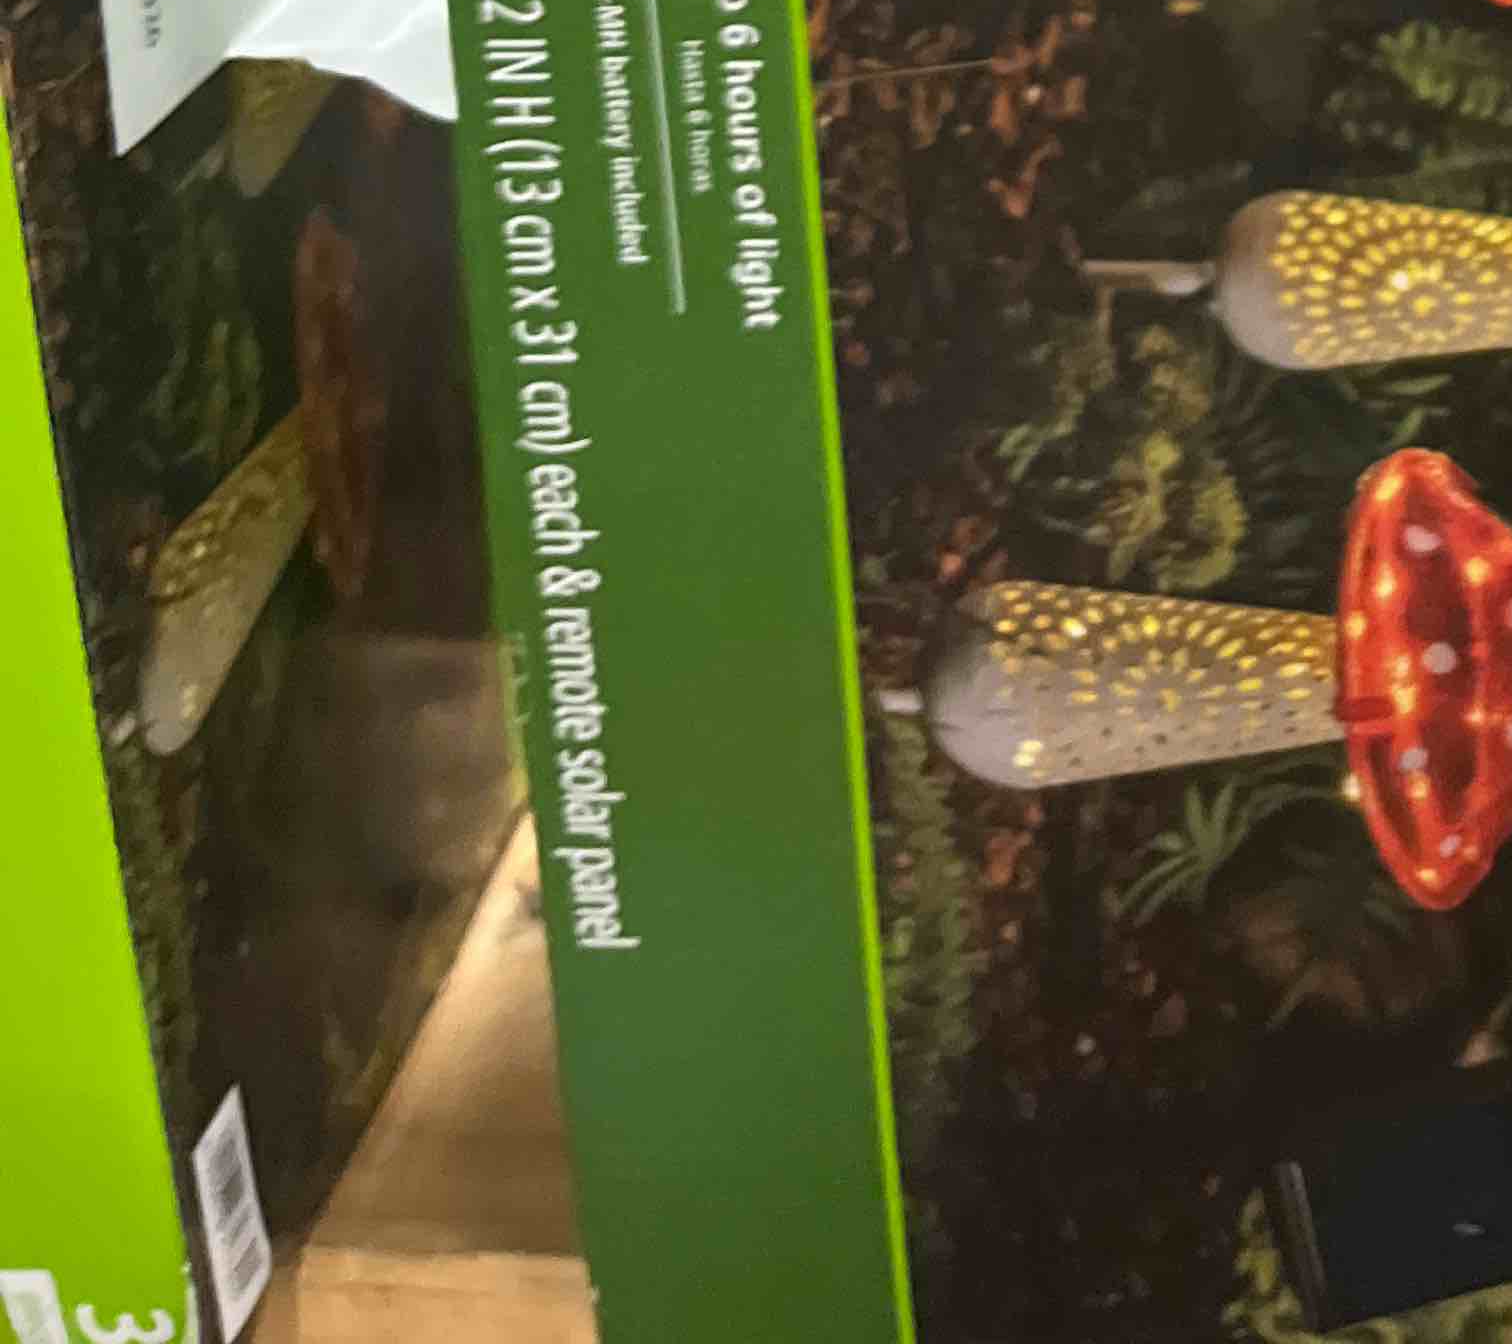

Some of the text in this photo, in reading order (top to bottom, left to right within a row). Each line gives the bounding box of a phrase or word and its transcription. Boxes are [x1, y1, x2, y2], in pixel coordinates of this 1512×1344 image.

[485, 39, 550, 82] IN
[720, 24, 759, 47] 6
[492, 97, 555, 125] H
[602, 56, 632, 148] battery
[680, 40, 712, 192] Hasta 6 horas
[723, 61, 763, 172] hours
[485, 140, 562, 203] (13
[735, 184, 776, 225] of
[504, 215, 554, 275] cm
[611, 157, 649, 264] included
[512, 287, 558, 309] x
[732, 239, 782, 327] light
[513, 321, 577, 363] 31
[518, 382, 590, 454] cm)
[530, 464, 600, 555] each
[540, 566, 601, 596] &
[545, 608, 605, 741] remote
[558, 749, 624, 840] solar
[554, 848, 640, 948] panel
